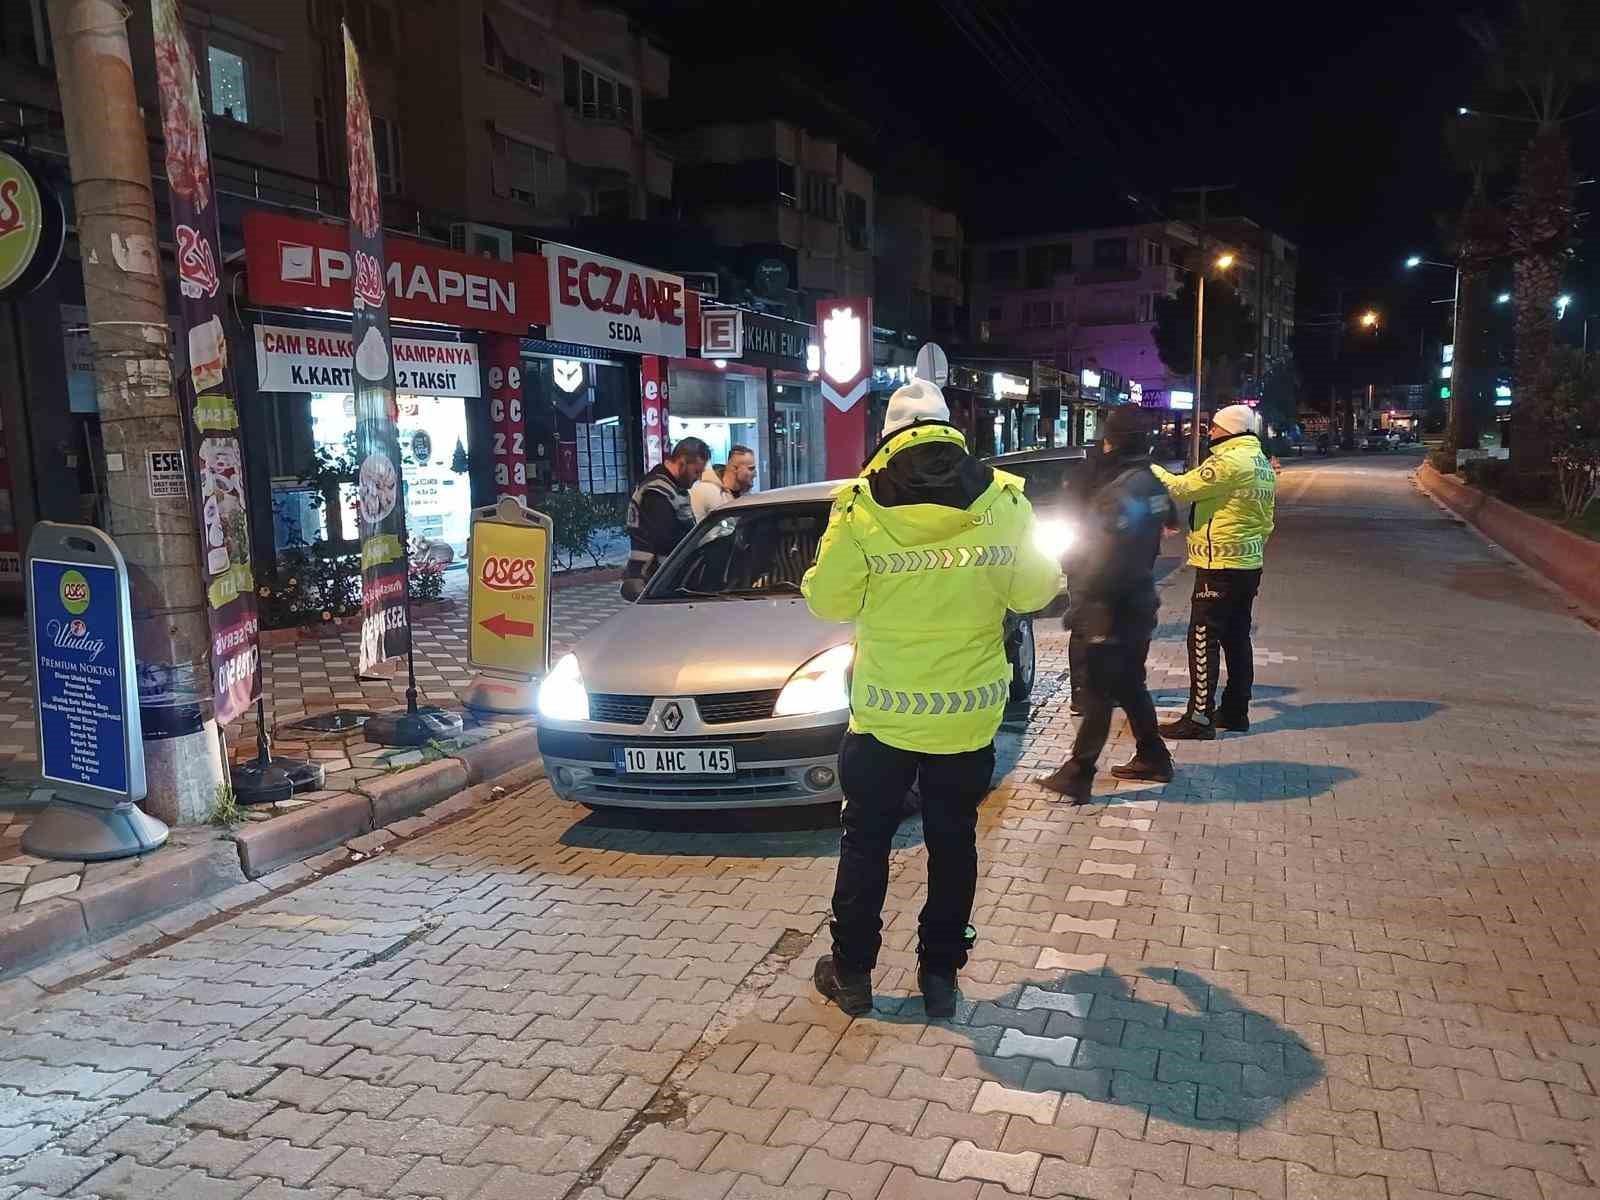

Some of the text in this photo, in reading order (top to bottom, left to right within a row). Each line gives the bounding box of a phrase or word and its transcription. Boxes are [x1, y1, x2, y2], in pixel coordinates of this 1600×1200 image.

[319, 247, 516, 315] PMAPEN
[558, 256, 683, 326] ECZANE
[608, 321, 642, 343] SEDA
[264, 333, 302, 354] CAM
[394, 344, 472, 365] KAMPANYA
[396, 371, 408, 389] 2
[411, 369, 456, 390] TAKSİT
[41, 656, 77, 671] PREMIUM
[79, 663, 116, 678] NOKTASI
[628, 750, 730, 771] 10 AHC 145
